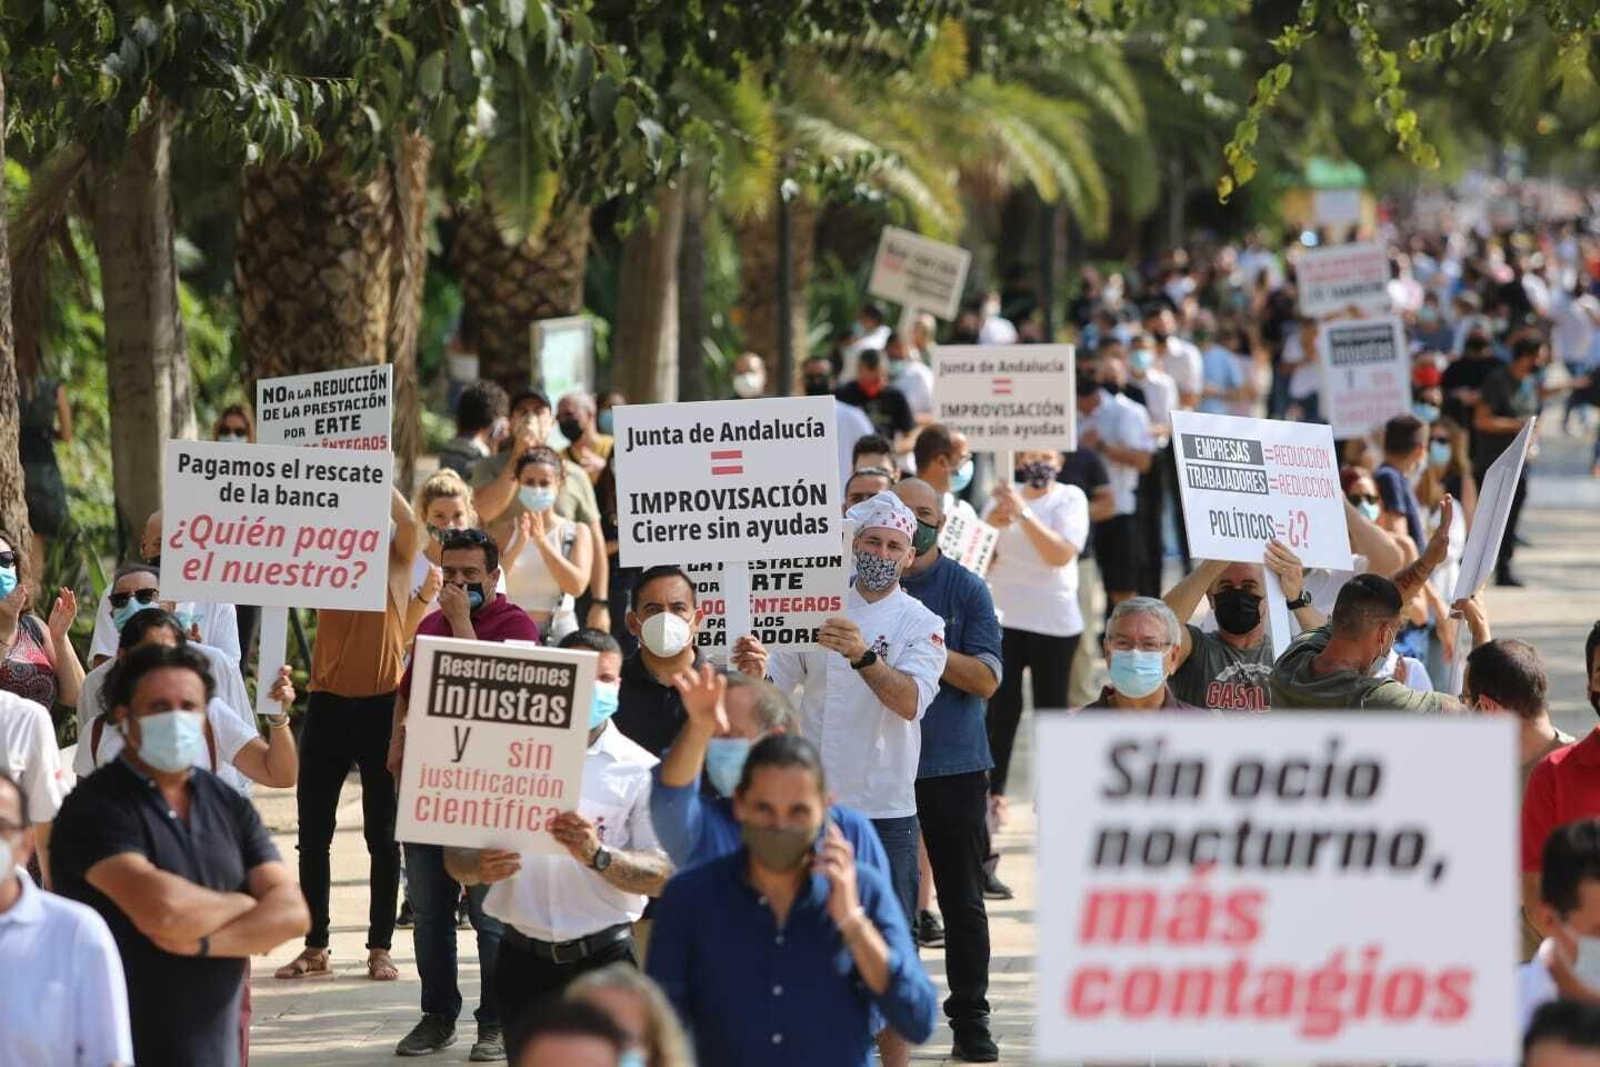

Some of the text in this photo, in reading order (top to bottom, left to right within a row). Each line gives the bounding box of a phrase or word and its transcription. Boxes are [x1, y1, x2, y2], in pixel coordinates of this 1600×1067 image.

[939, 359, 1065, 377] Junta de Andalucía
[262, 369, 387, 404] NO A LA REDUCCIÓN
[263, 392, 387, 421] DE LA PRESTACIÓN
[940, 399, 1065, 418] IMPROVISACIÓN
[284, 414, 361, 439] POR ERTE
[626, 417, 825, 452] Junta de Andalucía
[988, 421, 1010, 436] sin
[1013, 421, 1065, 439] ayudas
[1194, 436, 1250, 463] EMPRESAS
[177, 453, 384, 484] Pagamos el rescate
[1187, 465, 1267, 495] TRABAJADORES
[219, 482, 339, 508] de la banca
[629, 479, 828, 515] IMPROVISACIÓN
[168, 514, 380, 560] ¿Quién paga
[632, 512, 829, 543] Cierre sin ayudas
[182, 551, 368, 589] el nuestro?
[750, 572, 804, 591] RTE
[753, 616, 785, 628] LOS
[439, 654, 571, 687] Restricciones
[433, 679, 567, 725] injustas
[451, 725, 553, 770] y sin
[419, 763, 565, 799] justificación
[1102, 735, 1383, 801] Sin ocio
[414, 791, 562, 832] científica
[1091, 818, 1449, 884] nocturno,
[1078, 862, 1265, 945] más
[1066, 946, 1474, 1040] contagios
